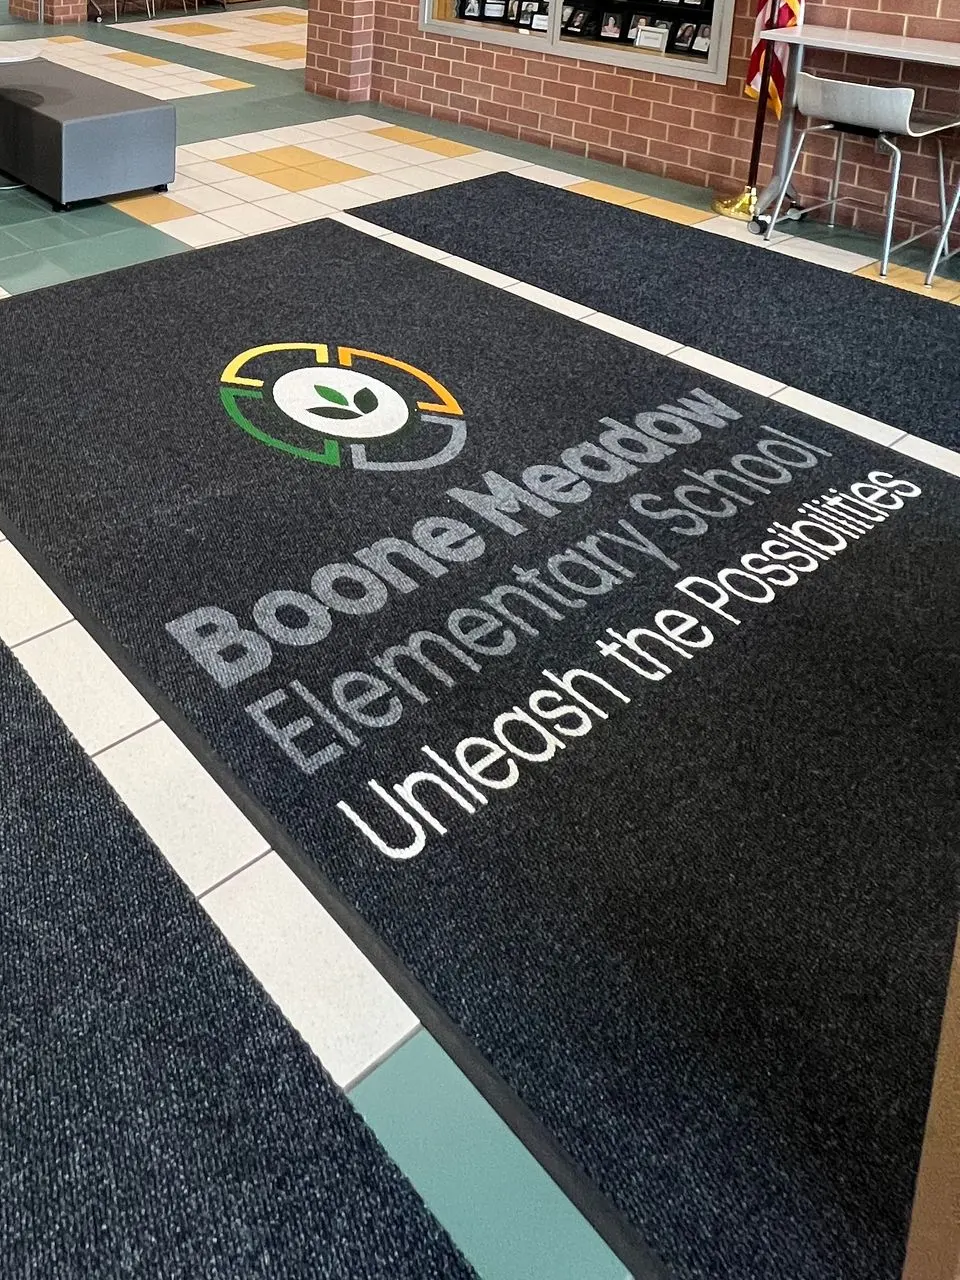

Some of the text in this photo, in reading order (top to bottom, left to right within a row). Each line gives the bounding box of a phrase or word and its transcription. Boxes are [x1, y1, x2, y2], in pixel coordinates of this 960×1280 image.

[165, 387, 744, 689] Boone Meadow
[244, 425, 833, 775] Elementary School
[337, 471, 922, 860] Unleash the Possibilities
